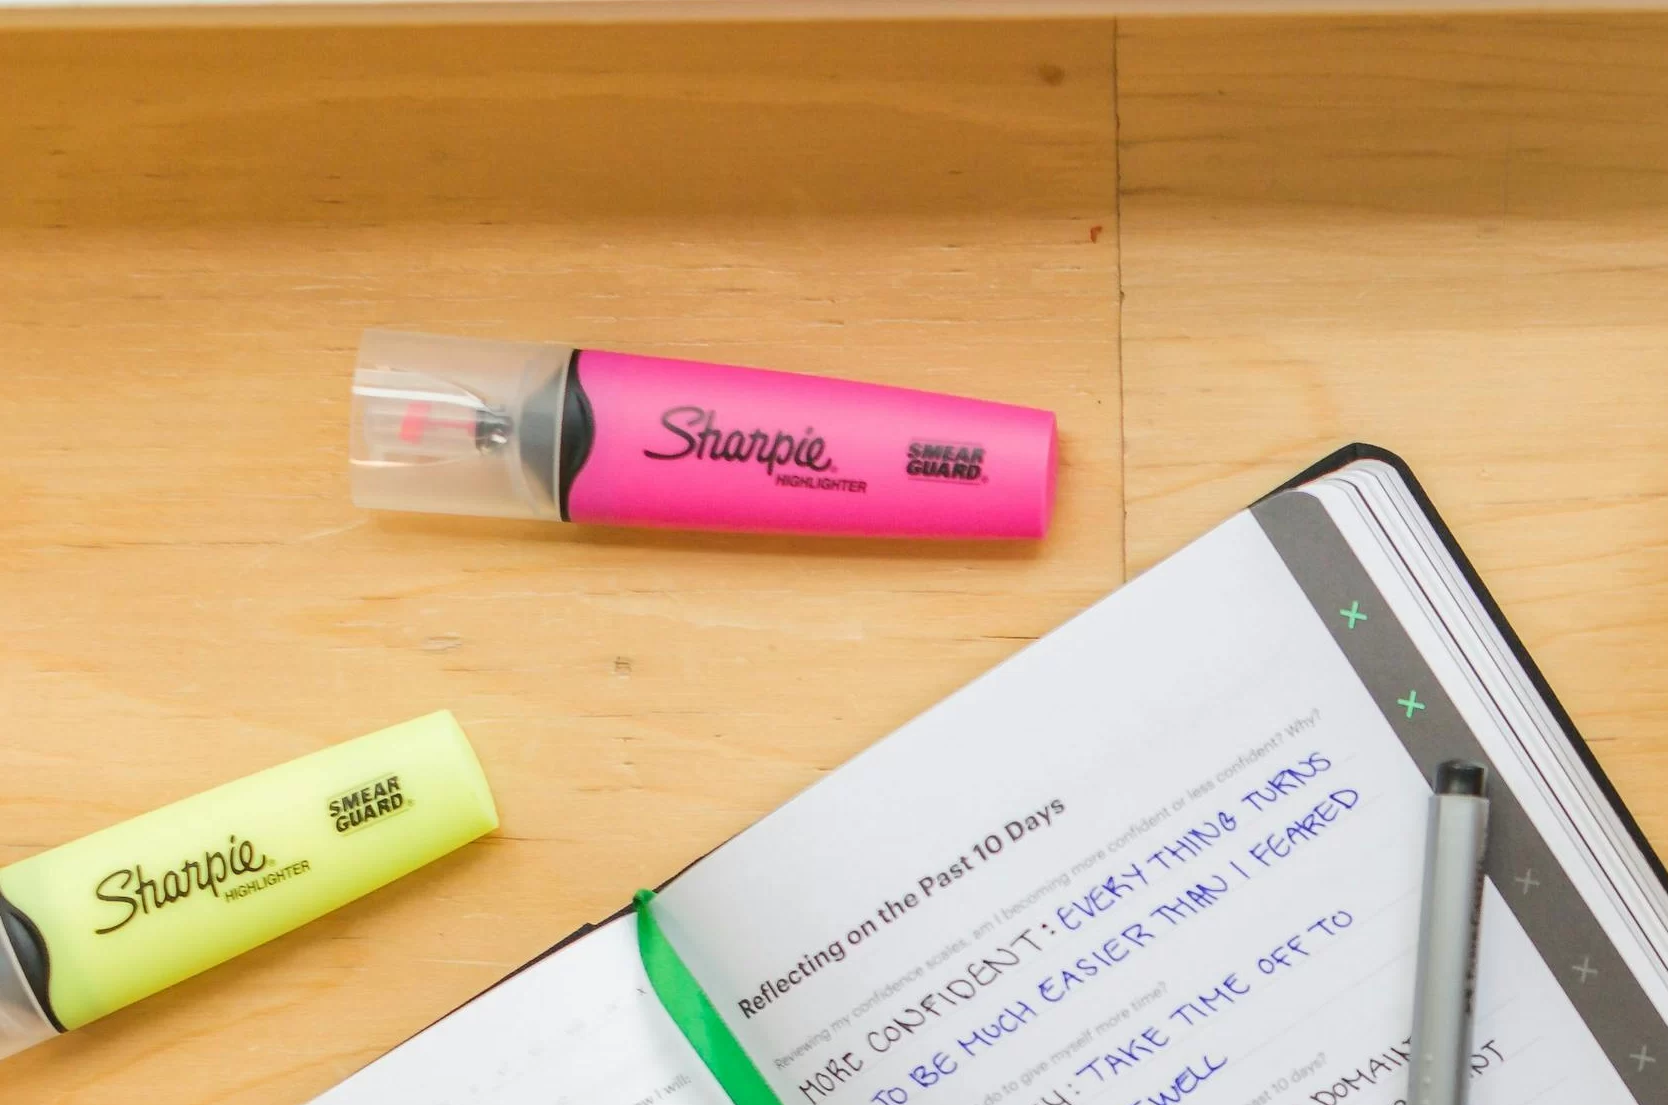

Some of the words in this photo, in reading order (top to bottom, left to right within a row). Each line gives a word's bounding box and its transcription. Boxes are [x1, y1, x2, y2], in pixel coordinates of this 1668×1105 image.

[643, 406, 833, 475] Sharpie
[907, 442, 984, 464] SMEAR
[776, 474, 867, 493] HIGHLIGHTER
[906, 457, 983, 481] GUARD
[328, 775, 401, 818] SMEAR
[1240, 752, 1332, 812] TURNS
[333, 791, 405, 833] GUARD
[94, 834, 267, 936] Sharpie
[222, 858, 310, 902] HIGHLIGHTER
[736, 940, 846, 1020] Reflecting
[846, 919, 878, 946] on
[876, 892, 919, 924] the
[917, 855, 974, 898] Past
[972, 834, 1003, 861] 10
[1003, 798, 1066, 842] Days
[908, 1051, 959, 1088] BE
[956, 1000, 1037, 1057] MUCH
[1037, 922, 1155, 1003] EASIER
[1149, 874, 1229, 925] THAN
[1229, 860, 1251, 880] I
[1248, 788, 1360, 867] FEARED
[1074, 1027, 1170, 1081] TAKE
[1169, 973, 1251, 1026] TIME
[1257, 934, 1310, 975] OFF
[1306, 910, 1354, 936] TO
